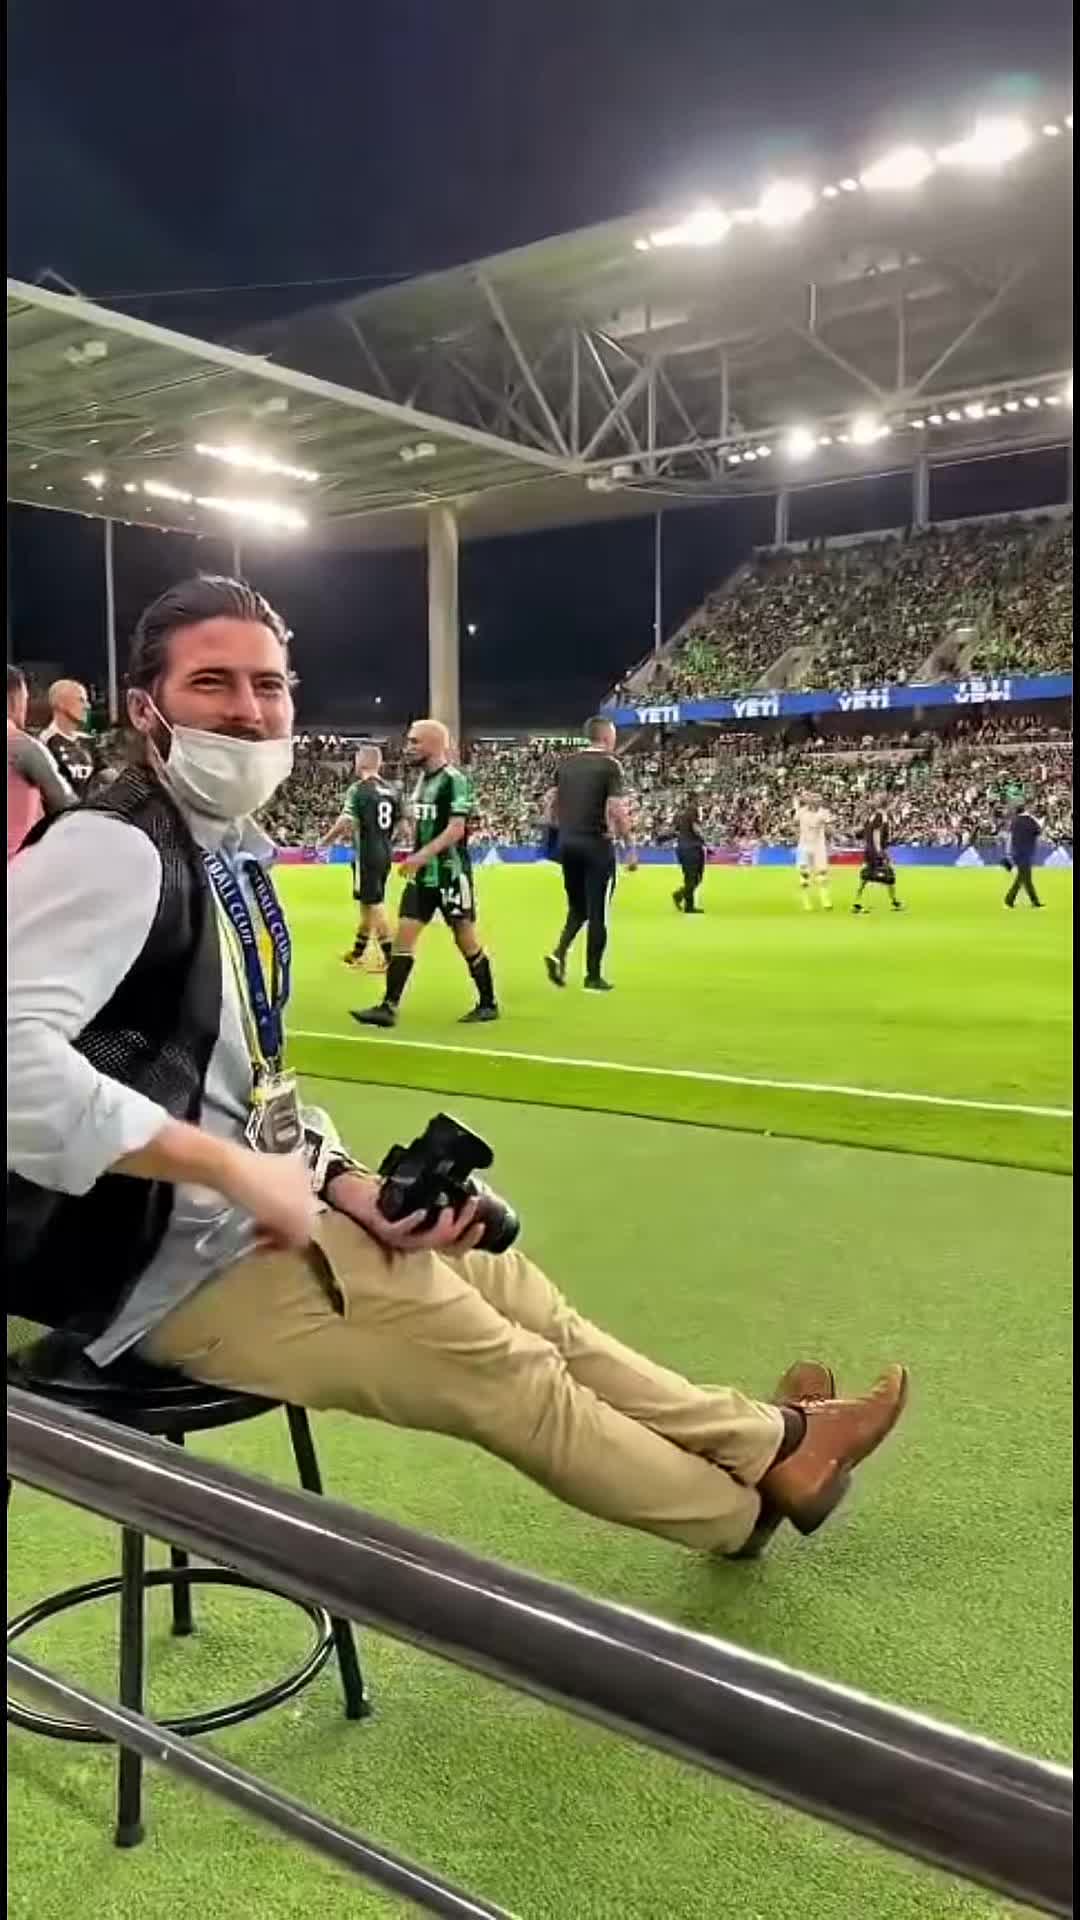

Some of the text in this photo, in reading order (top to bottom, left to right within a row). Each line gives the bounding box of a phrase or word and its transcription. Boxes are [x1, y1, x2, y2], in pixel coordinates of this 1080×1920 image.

[635, 704, 680, 724] YETI
[733, 695, 779, 718] YETI
[377, 800, 393, 829] 8
